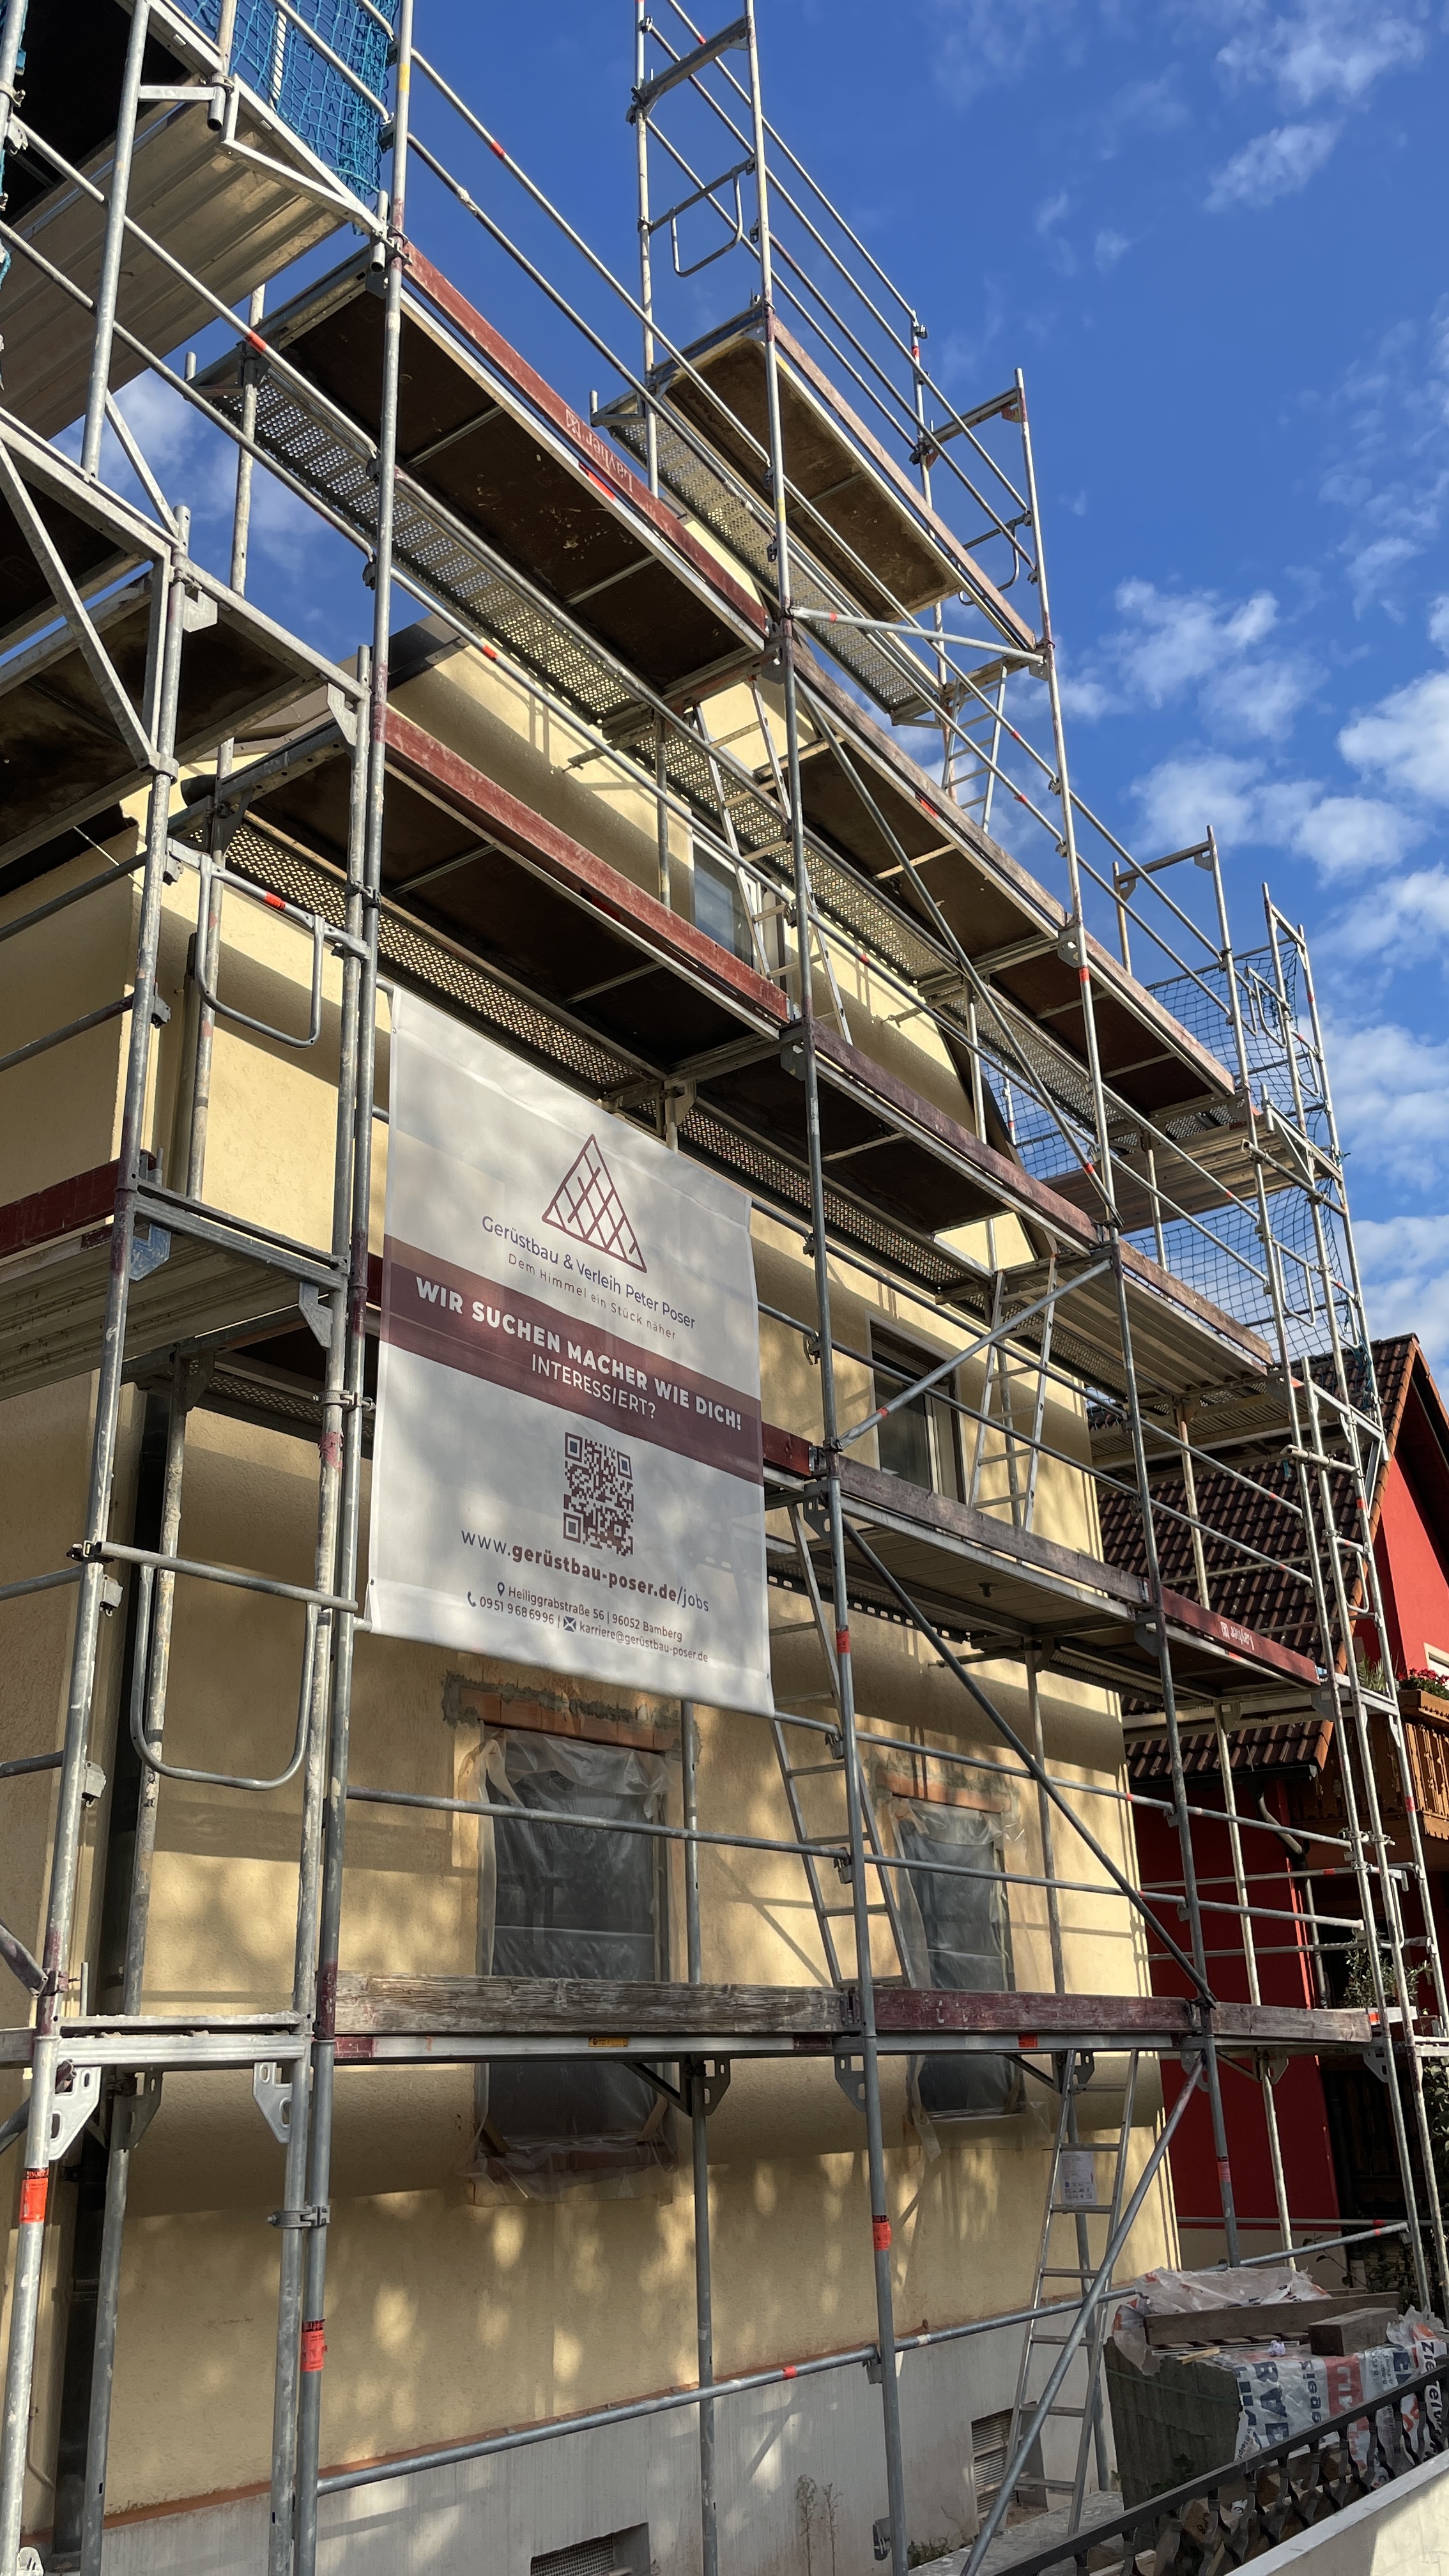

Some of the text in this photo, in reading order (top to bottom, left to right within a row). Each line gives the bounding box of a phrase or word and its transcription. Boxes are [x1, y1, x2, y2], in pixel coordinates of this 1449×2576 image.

[586, 432, 633, 493] Layher
[482, 1215, 696, 1330] Gerüstbau & Verleih Peter Poser
[509, 1253, 676, 1340] Dem Himmel ein Stück näher
[416, 1276, 742, 1431] WIR SUCHEN MACHER WIE DICH!
[532, 1353, 656, 1419] INTERESSIERT?
[461, 1529, 709, 1612] www.gerüstbau-poser.de/jobs
[480, 1596, 503, 1612] 0951
[579, 1620, 709, 1662] karriere@gerüstbau-poser.de
[509, 1586, 590, 1617] Heiliggrabstraße
[593, 1608, 604, 1620] 56
[612, 1613, 640, 1630] 96052
[643, 1621, 682, 1643] Bamberg
